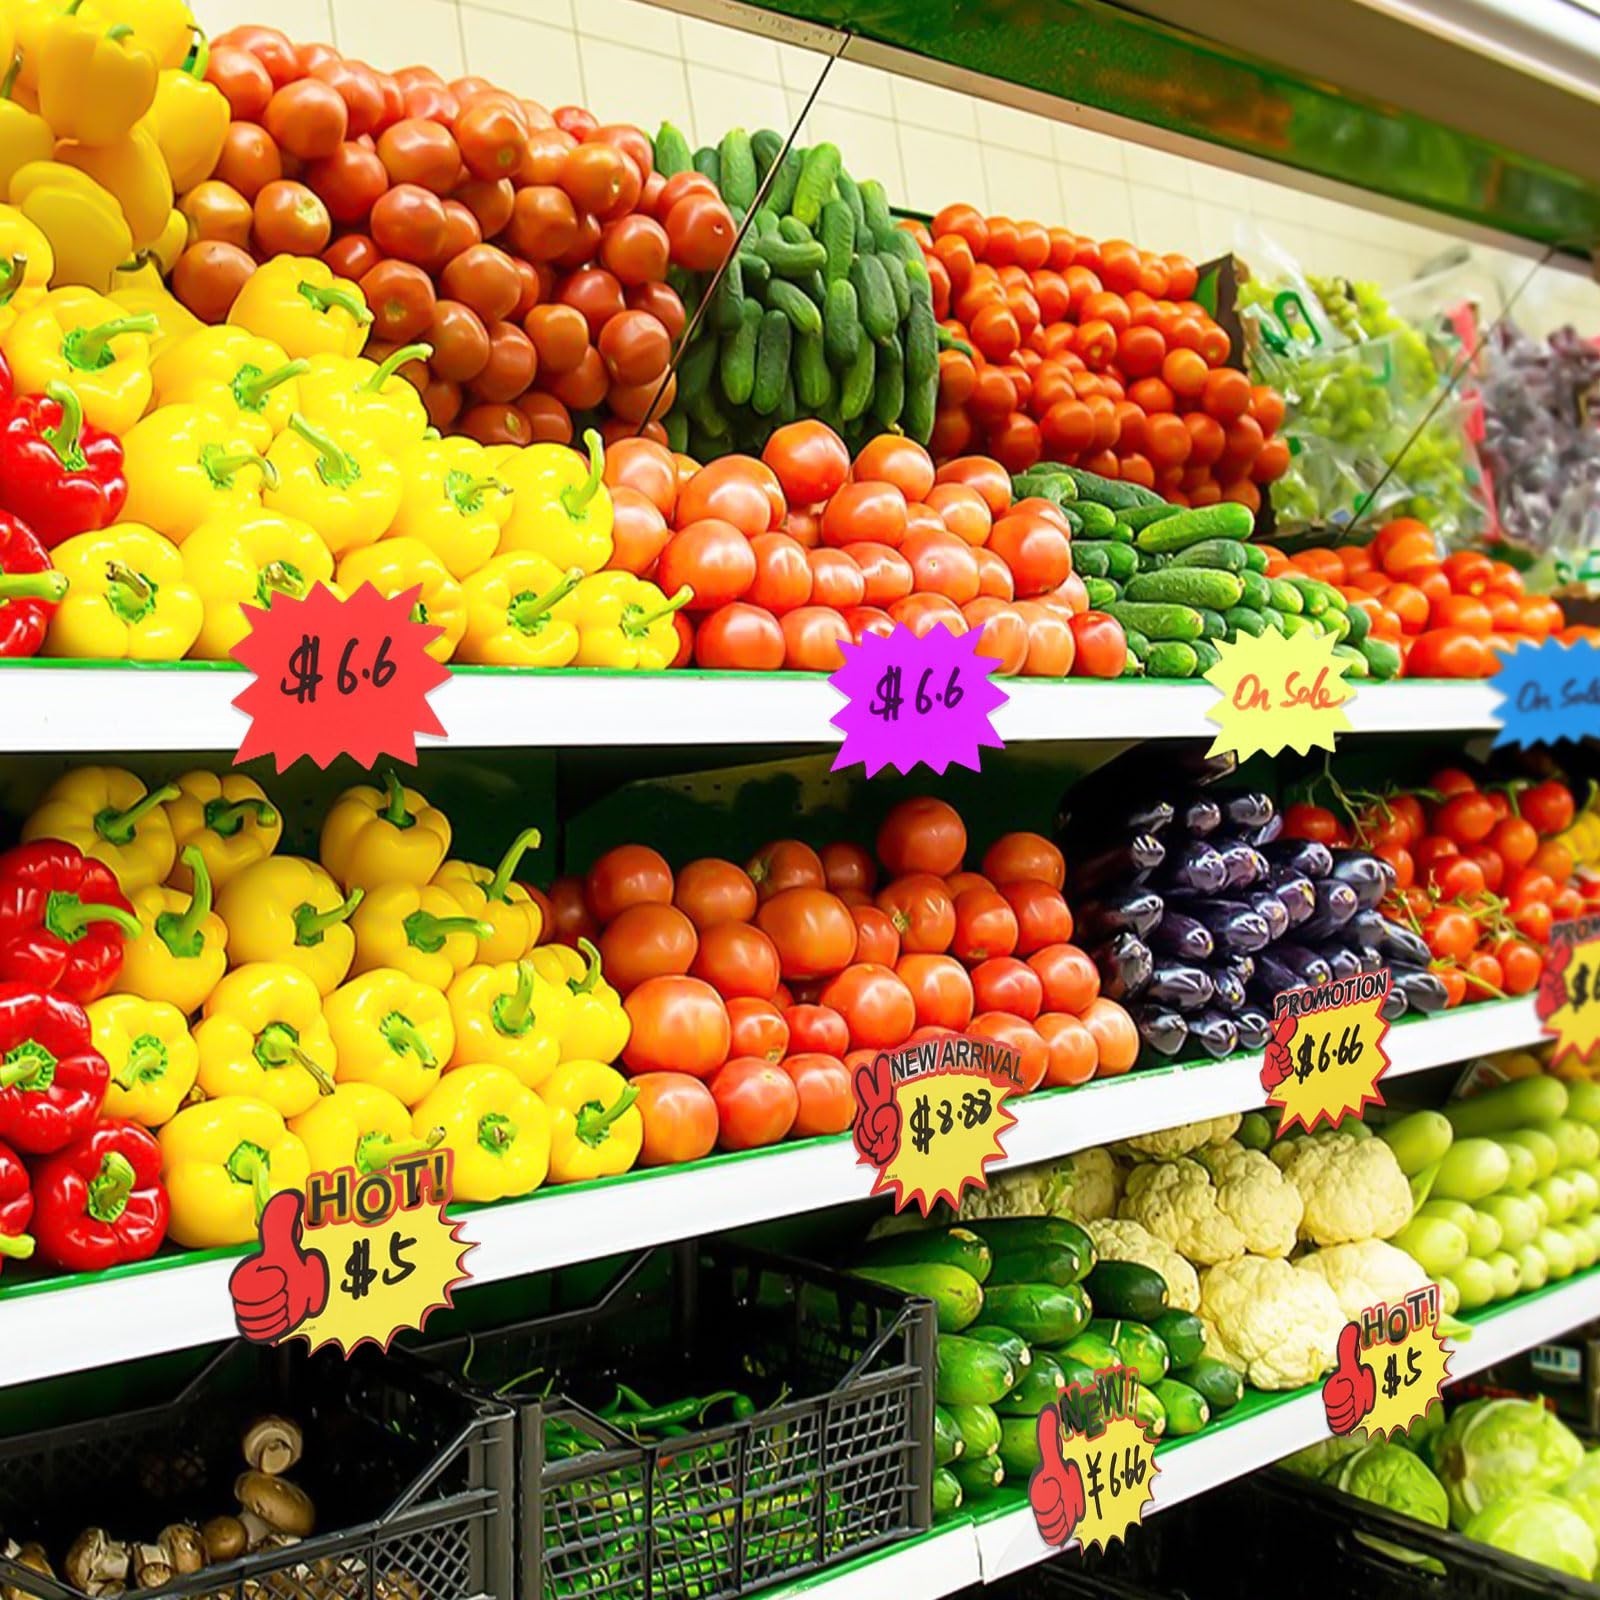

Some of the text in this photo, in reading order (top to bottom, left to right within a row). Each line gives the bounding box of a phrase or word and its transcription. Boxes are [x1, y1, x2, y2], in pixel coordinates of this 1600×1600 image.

[1232, 666, 1346, 712] On Sale
[1516, 680, 1553, 712] On
[1273, 970, 1390, 1020] PROMOTION
[889, 1039, 1025, 1086] NEW ARRIVAL
[1294, 1023, 1364, 1085] $6.66
[307, 1155, 448, 1226] HOT!
[340, 1231, 418, 1301] $5
[1362, 1288, 1436, 1349] HOT!
[1381, 1346, 1423, 1400] $5
[1059, 1368, 1139, 1440] NEW!
[1085, 1444, 1147, 1521] ¥6.66
